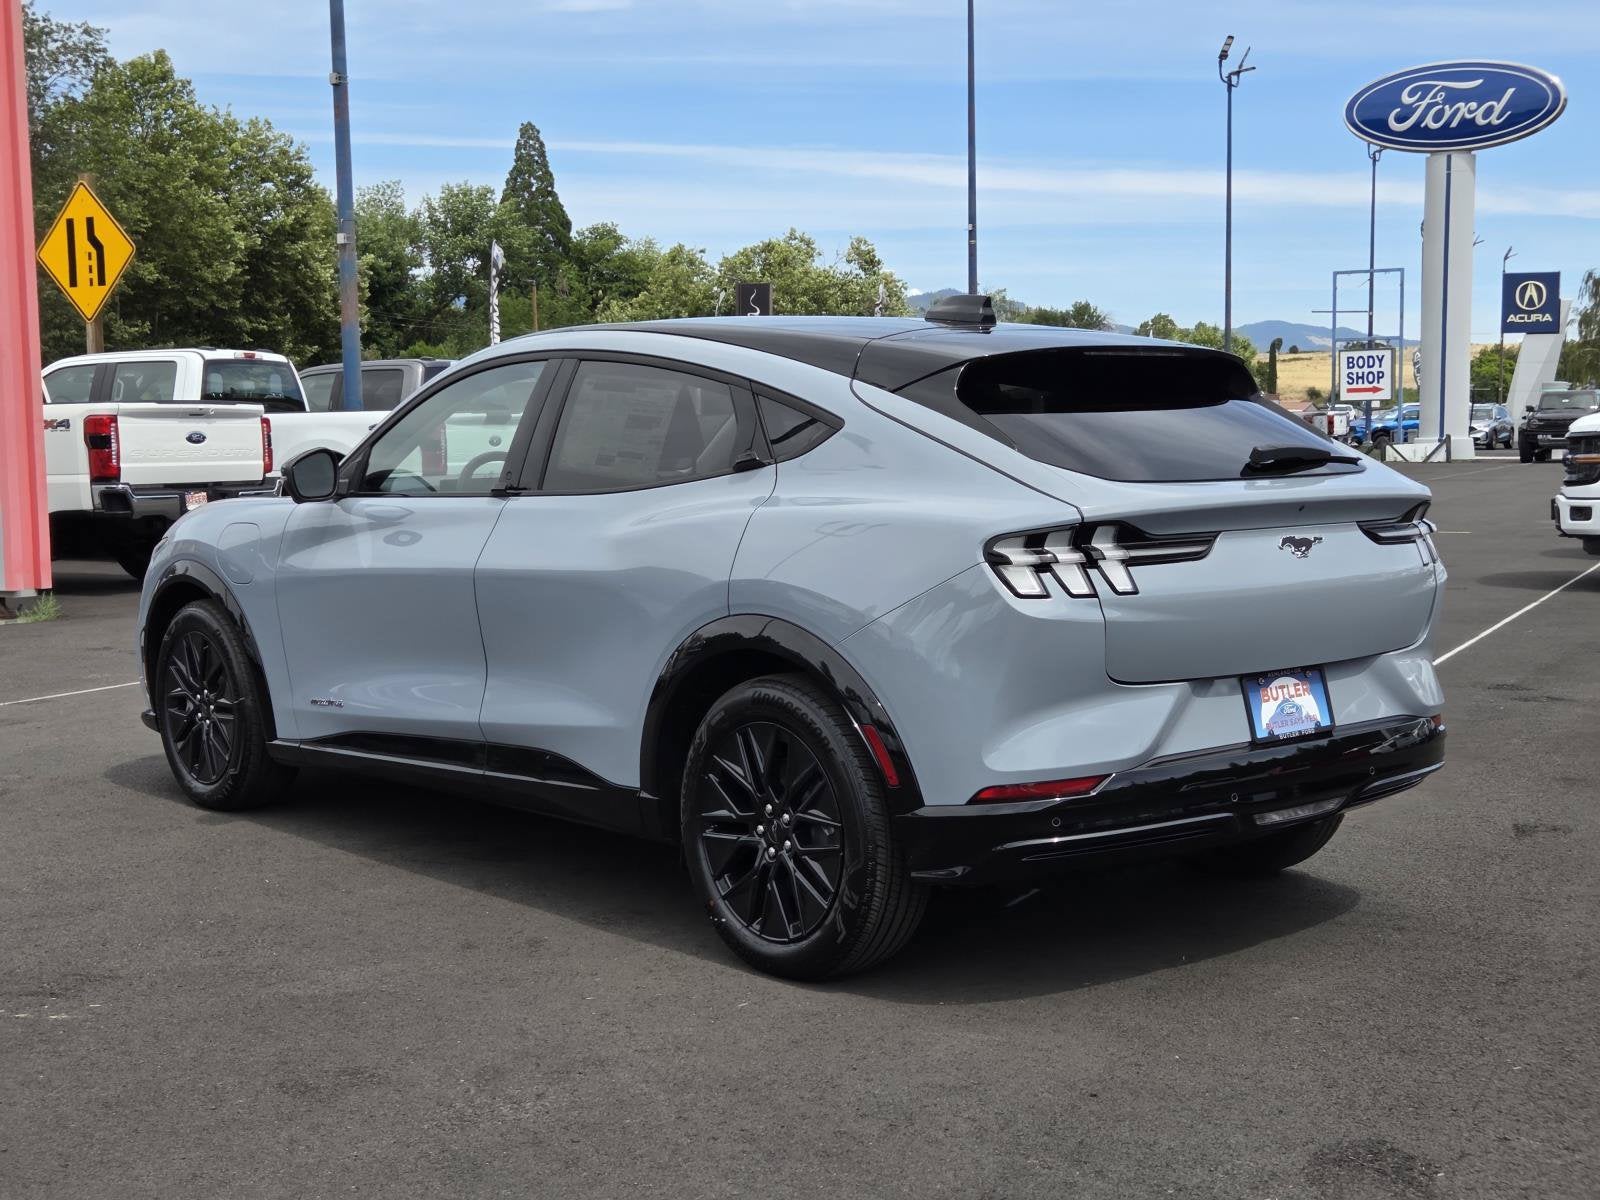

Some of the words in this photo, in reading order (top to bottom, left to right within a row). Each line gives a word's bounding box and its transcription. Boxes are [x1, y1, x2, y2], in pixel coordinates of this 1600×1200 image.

[1388, 79, 1515, 131] Ford
[1507, 313, 1552, 322] ACURA
[1346, 355, 1384, 369] BODY
[1346, 371, 1384, 385] SHOP
[43, 419, 70, 429] X4
[1261, 681, 1310, 703] BUTLER
[1279, 731, 1300, 740] BUTLER
